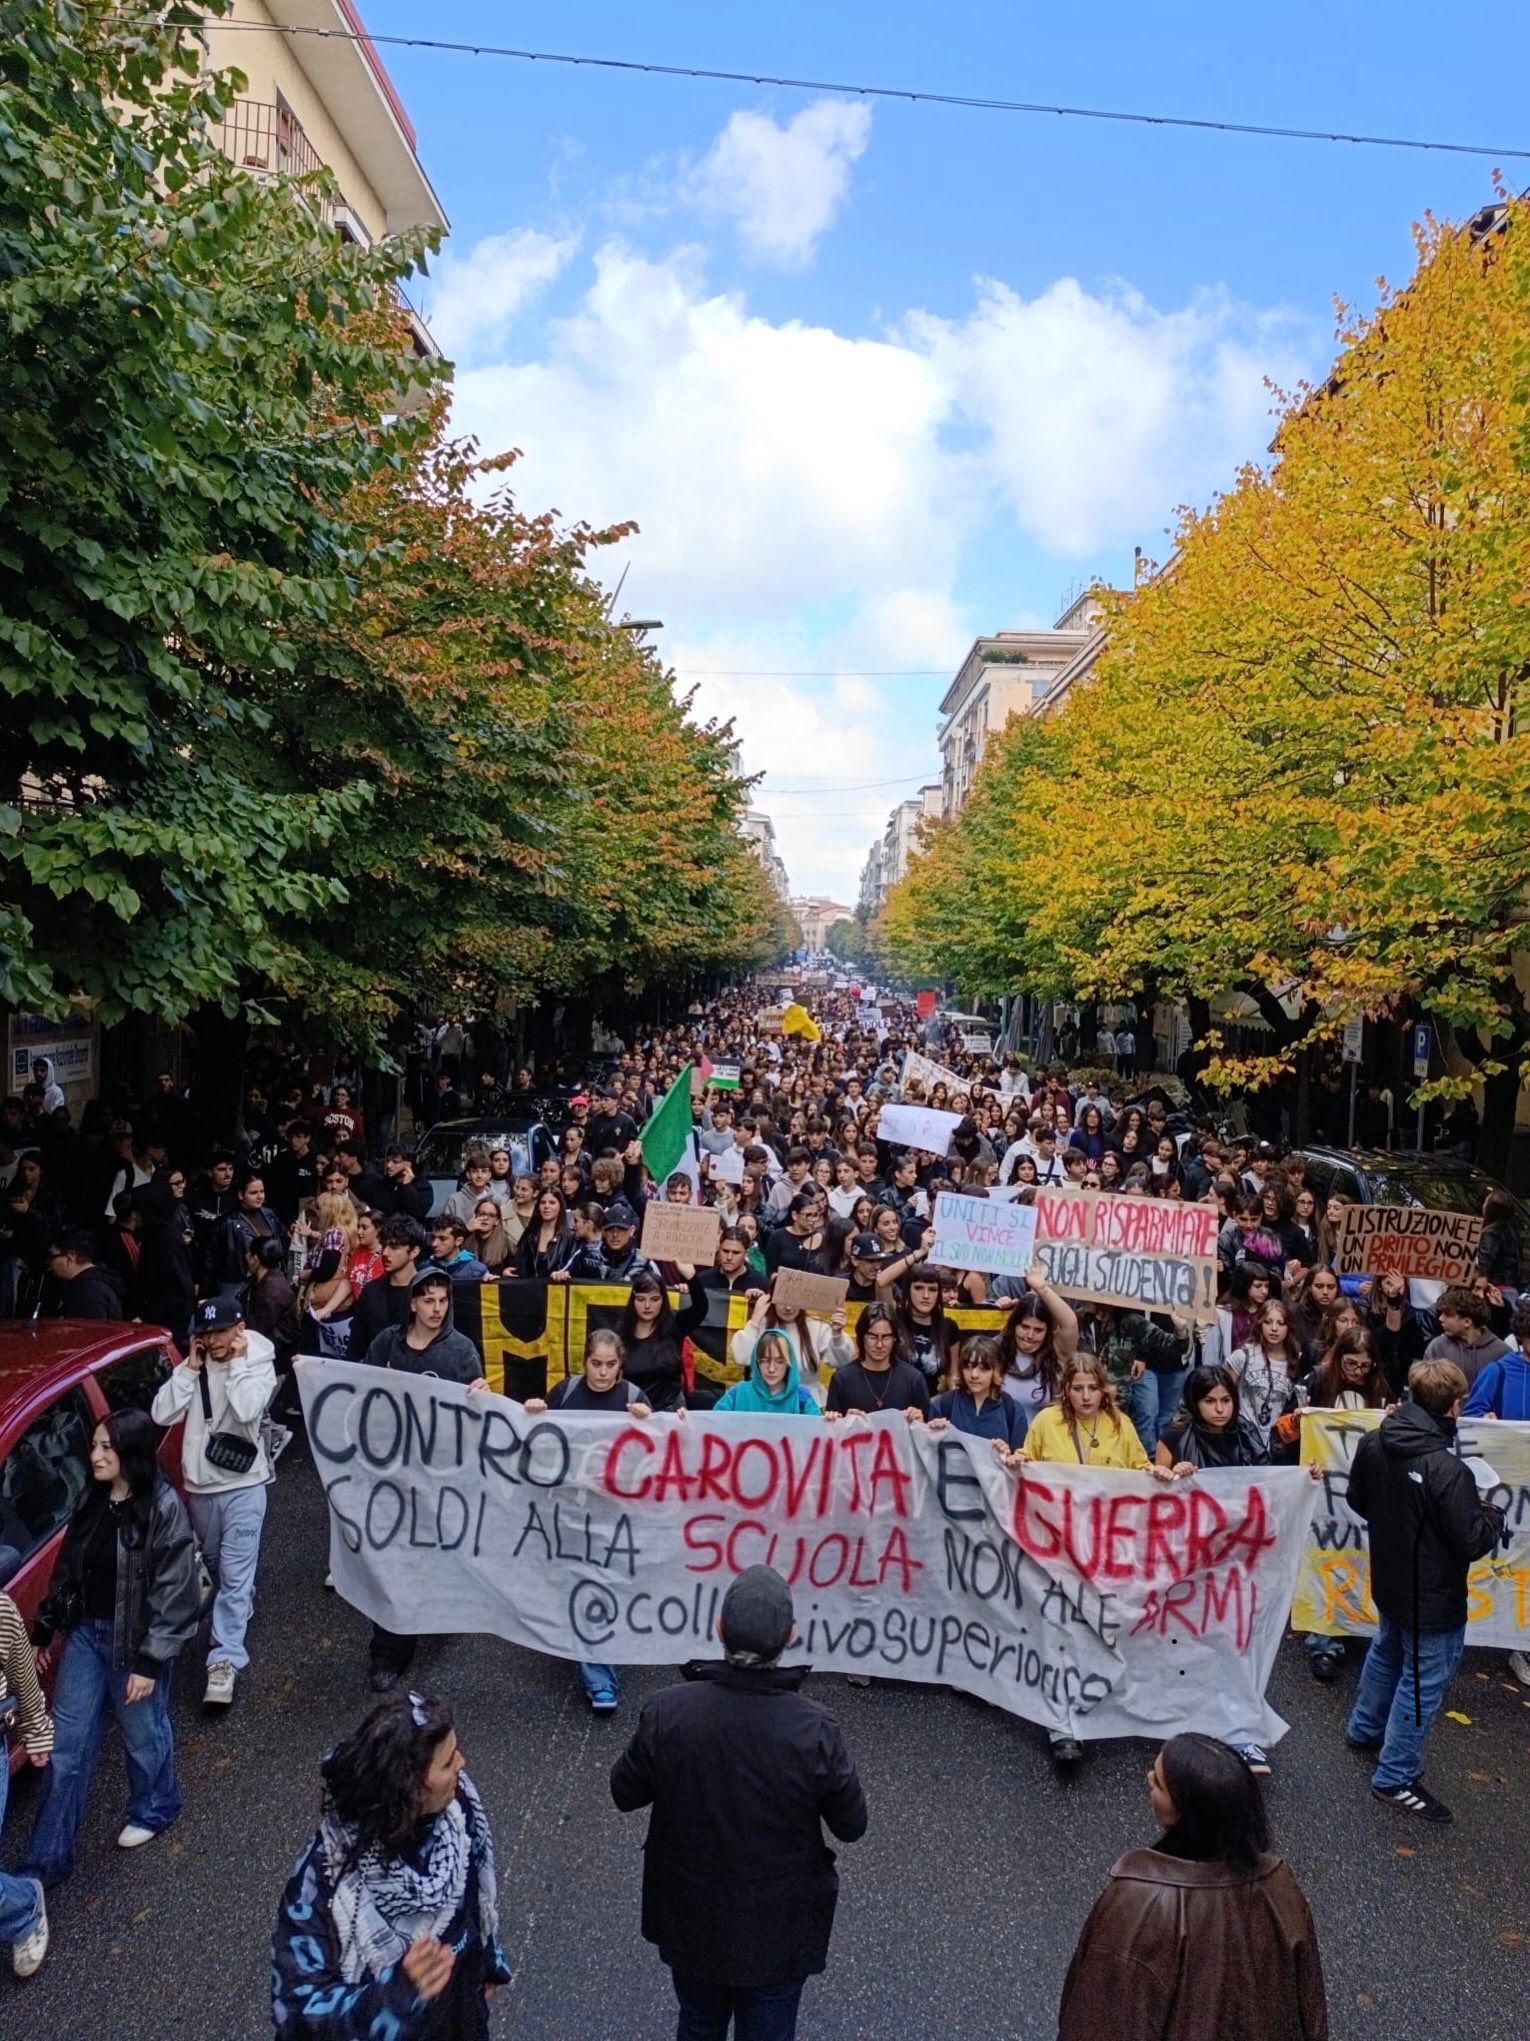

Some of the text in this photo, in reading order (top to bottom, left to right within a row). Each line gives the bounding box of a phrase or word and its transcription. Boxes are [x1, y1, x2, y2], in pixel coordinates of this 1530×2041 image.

[1417, 1031, 1426, 1053] P
[941, 1197, 1030, 1229] UNITI SI
[1035, 1195, 1217, 1257] NON RISPARMIATE
[966, 1224, 1015, 1248] VINCE
[1343, 1234, 1479, 1261] UN DIRITTO NON
[1037, 1244, 1089, 1288] SUGLI
[1341, 1255, 1364, 1273] UN
[310, 1383, 570, 1488] CONTRO
[603, 1428, 911, 1519] CAROVITA
[937, 1441, 985, 1521] E
[1013, 1475, 1277, 1583] GUERRA
[327, 1475, 487, 1557] SOLDI
[513, 1501, 641, 1576] ALLA
[683, 1514, 924, 1593] SCUOLA
[943, 1529, 1025, 1610] NON
